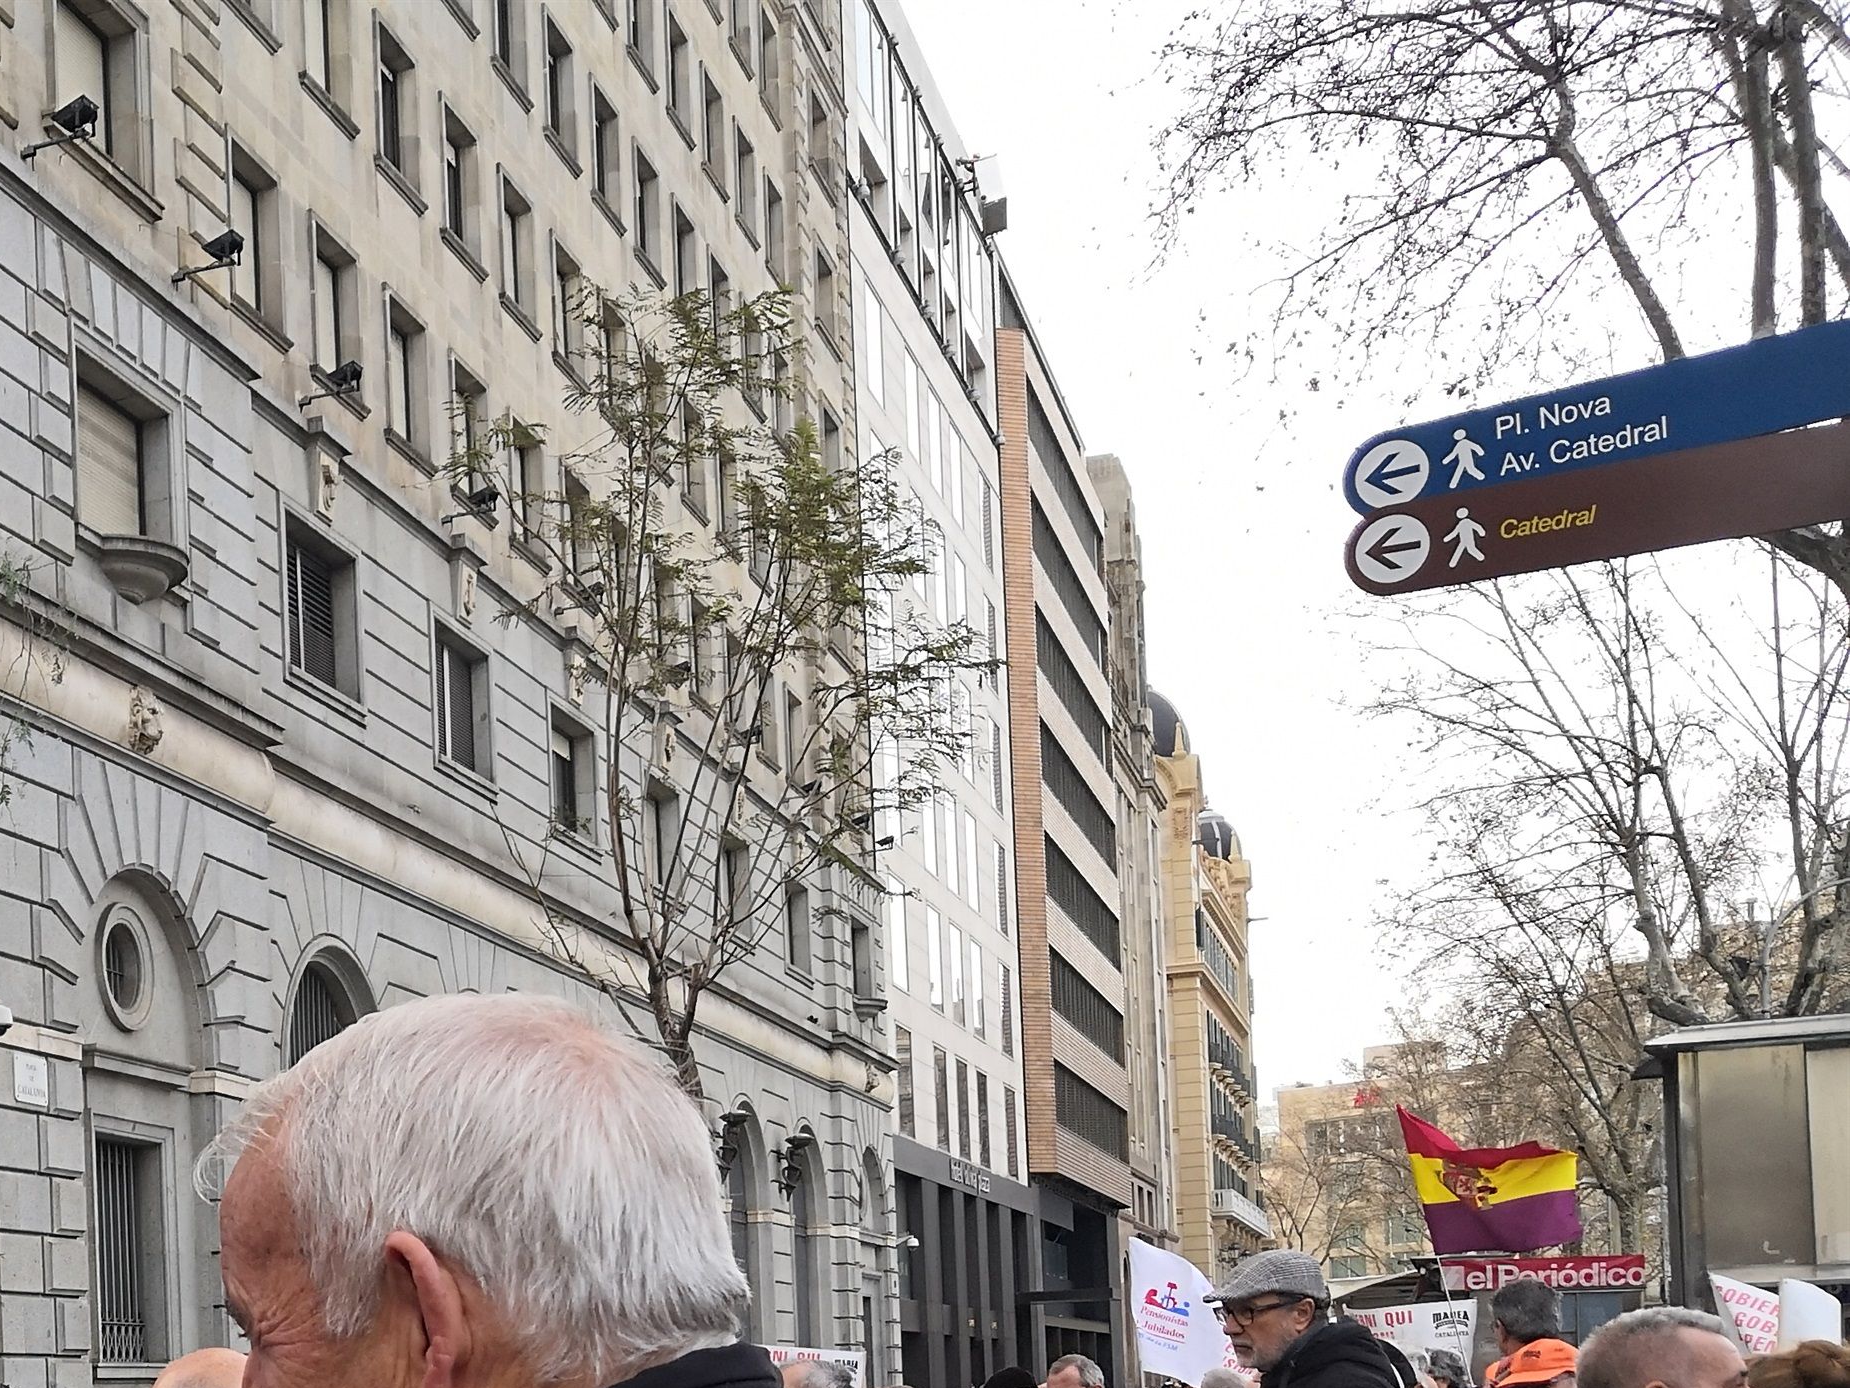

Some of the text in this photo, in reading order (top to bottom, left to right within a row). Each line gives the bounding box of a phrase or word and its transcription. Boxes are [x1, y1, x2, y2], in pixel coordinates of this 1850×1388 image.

[1495, 396, 1611, 439] Pl. Nova
[1500, 415, 1668, 476] Av. Catedral
[1500, 504, 1597, 539] Catedral
[1466, 1264, 1493, 1290] el
[1142, 1320, 1185, 1339] Jubilados
[1384, 1310, 1413, 1328] QUI
